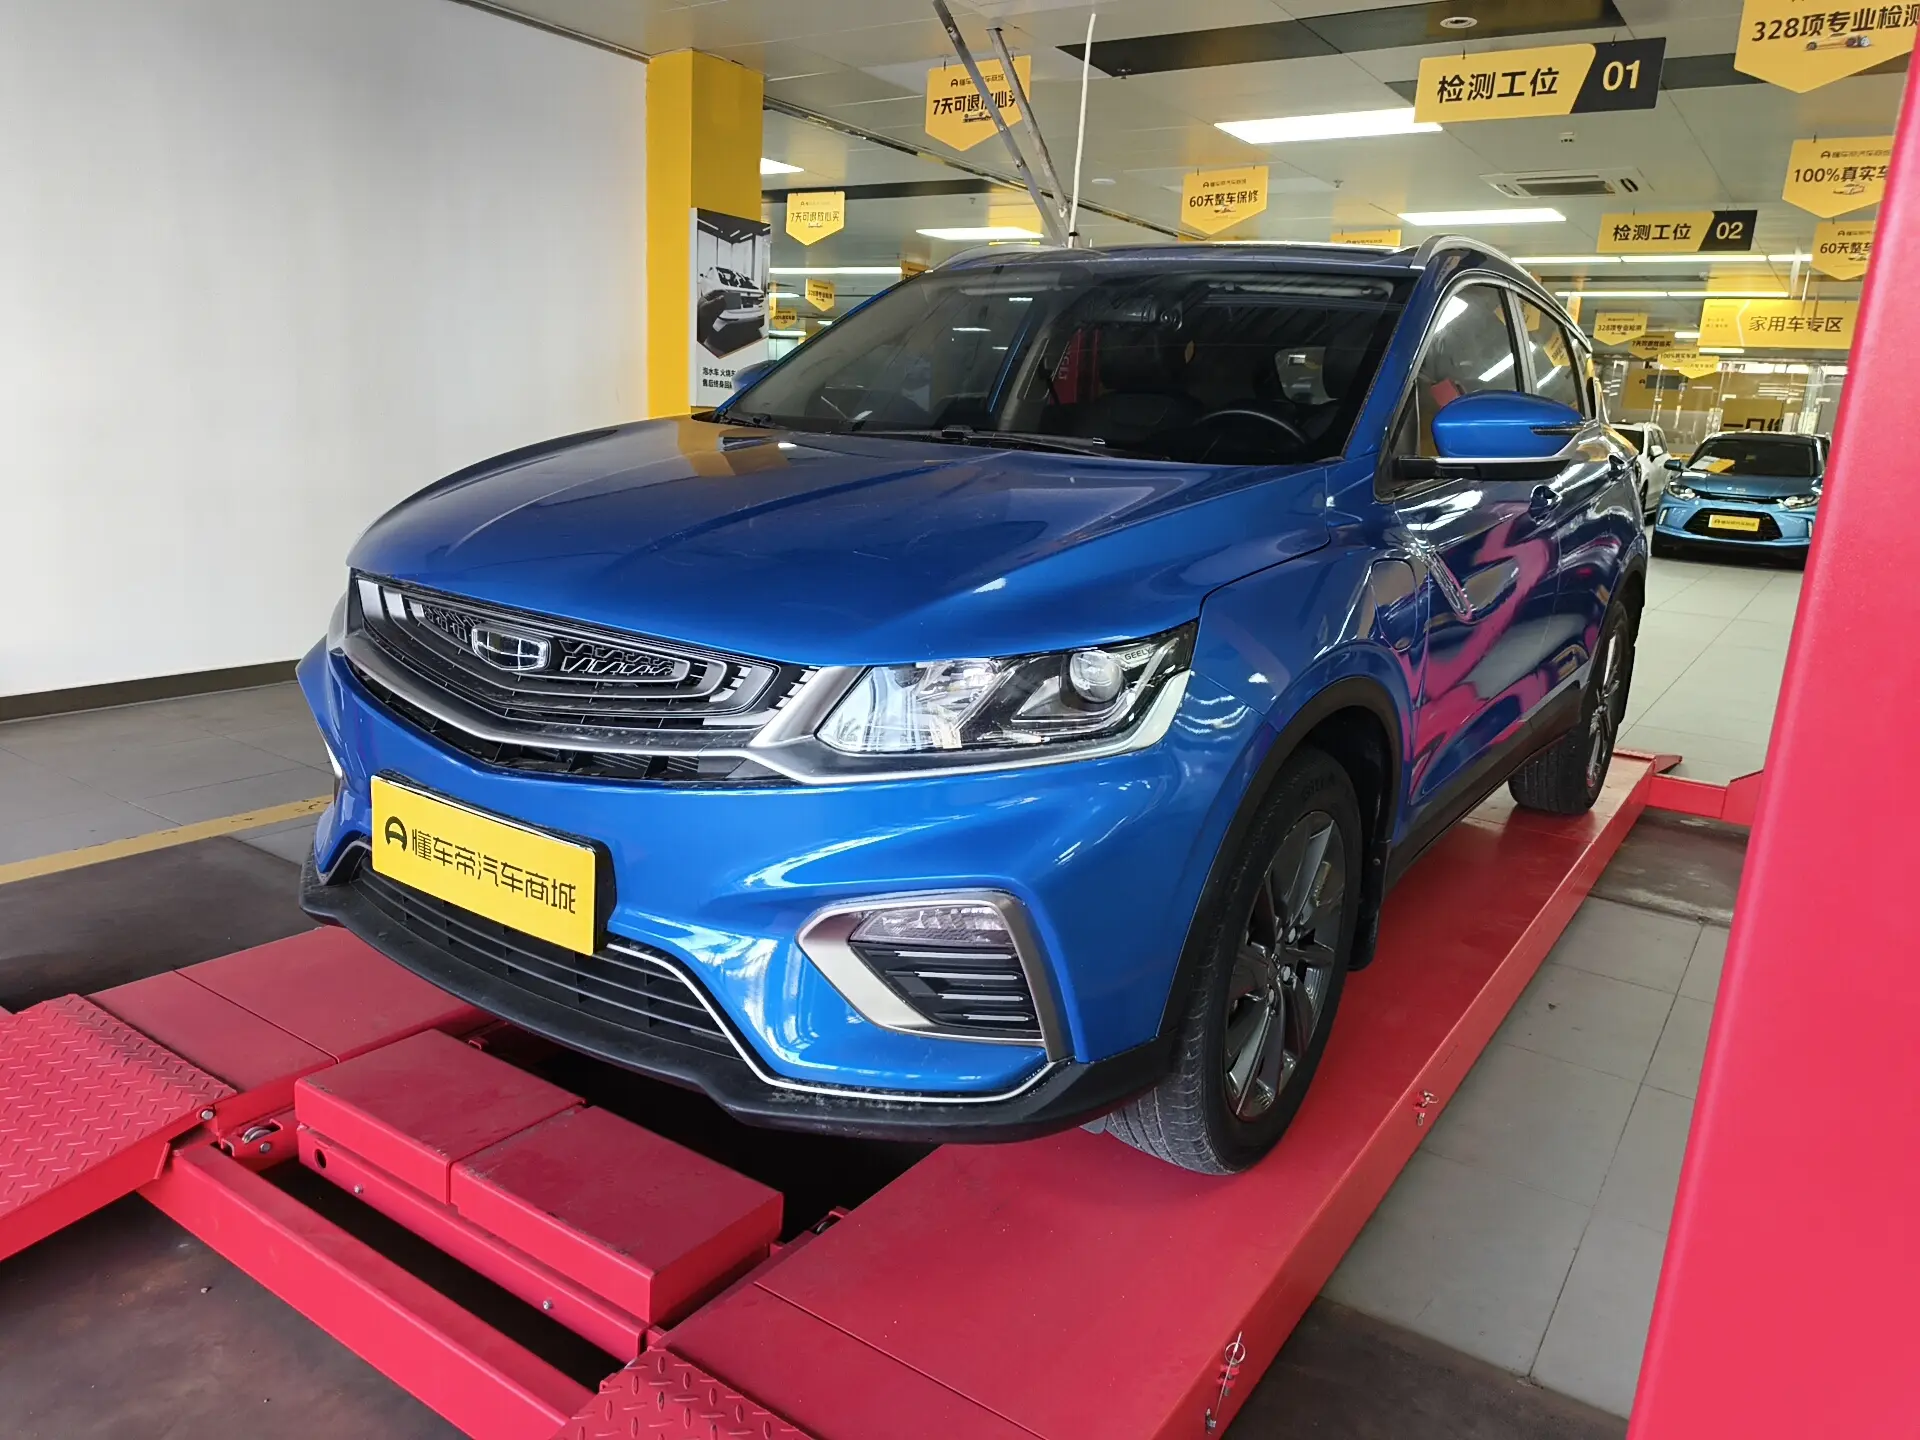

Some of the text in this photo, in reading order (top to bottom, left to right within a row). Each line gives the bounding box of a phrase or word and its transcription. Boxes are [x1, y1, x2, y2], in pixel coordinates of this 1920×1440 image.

[1437, 60, 1641, 103] 检测工位 01
[1189, 189, 1259, 208] 60天整车保修
[1612, 221, 1744, 242] 检测工位 02
[1749, 315, 1844, 333] 家用车专区
[1124, 647, 1151, 660] GEELY
[411, 828, 576, 915] 懂车帝汽车商城
